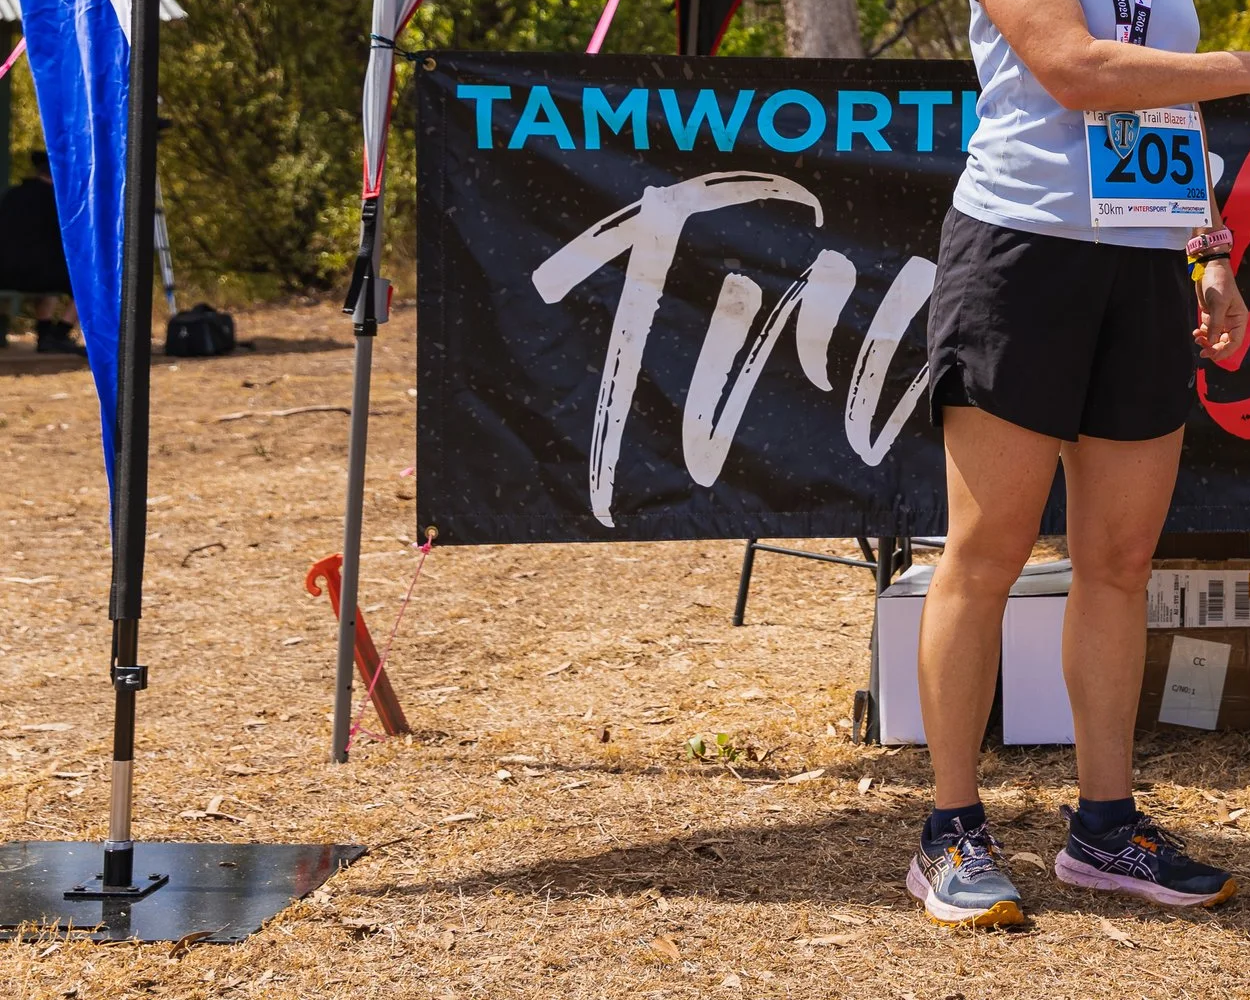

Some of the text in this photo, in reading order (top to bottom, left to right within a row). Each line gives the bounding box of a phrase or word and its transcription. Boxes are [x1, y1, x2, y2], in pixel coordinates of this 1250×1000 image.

[1135, 10, 1147, 33] 2026
[1142, 111, 1187, 125] Trail Blazer
[1104, 132, 1194, 185] 205
[1186, 187, 1205, 199] 2026
[1098, 203, 1124, 215] 30km
[1133, 205, 1167, 213] INTERSPORT
[1193, 656, 1206, 667] CC
